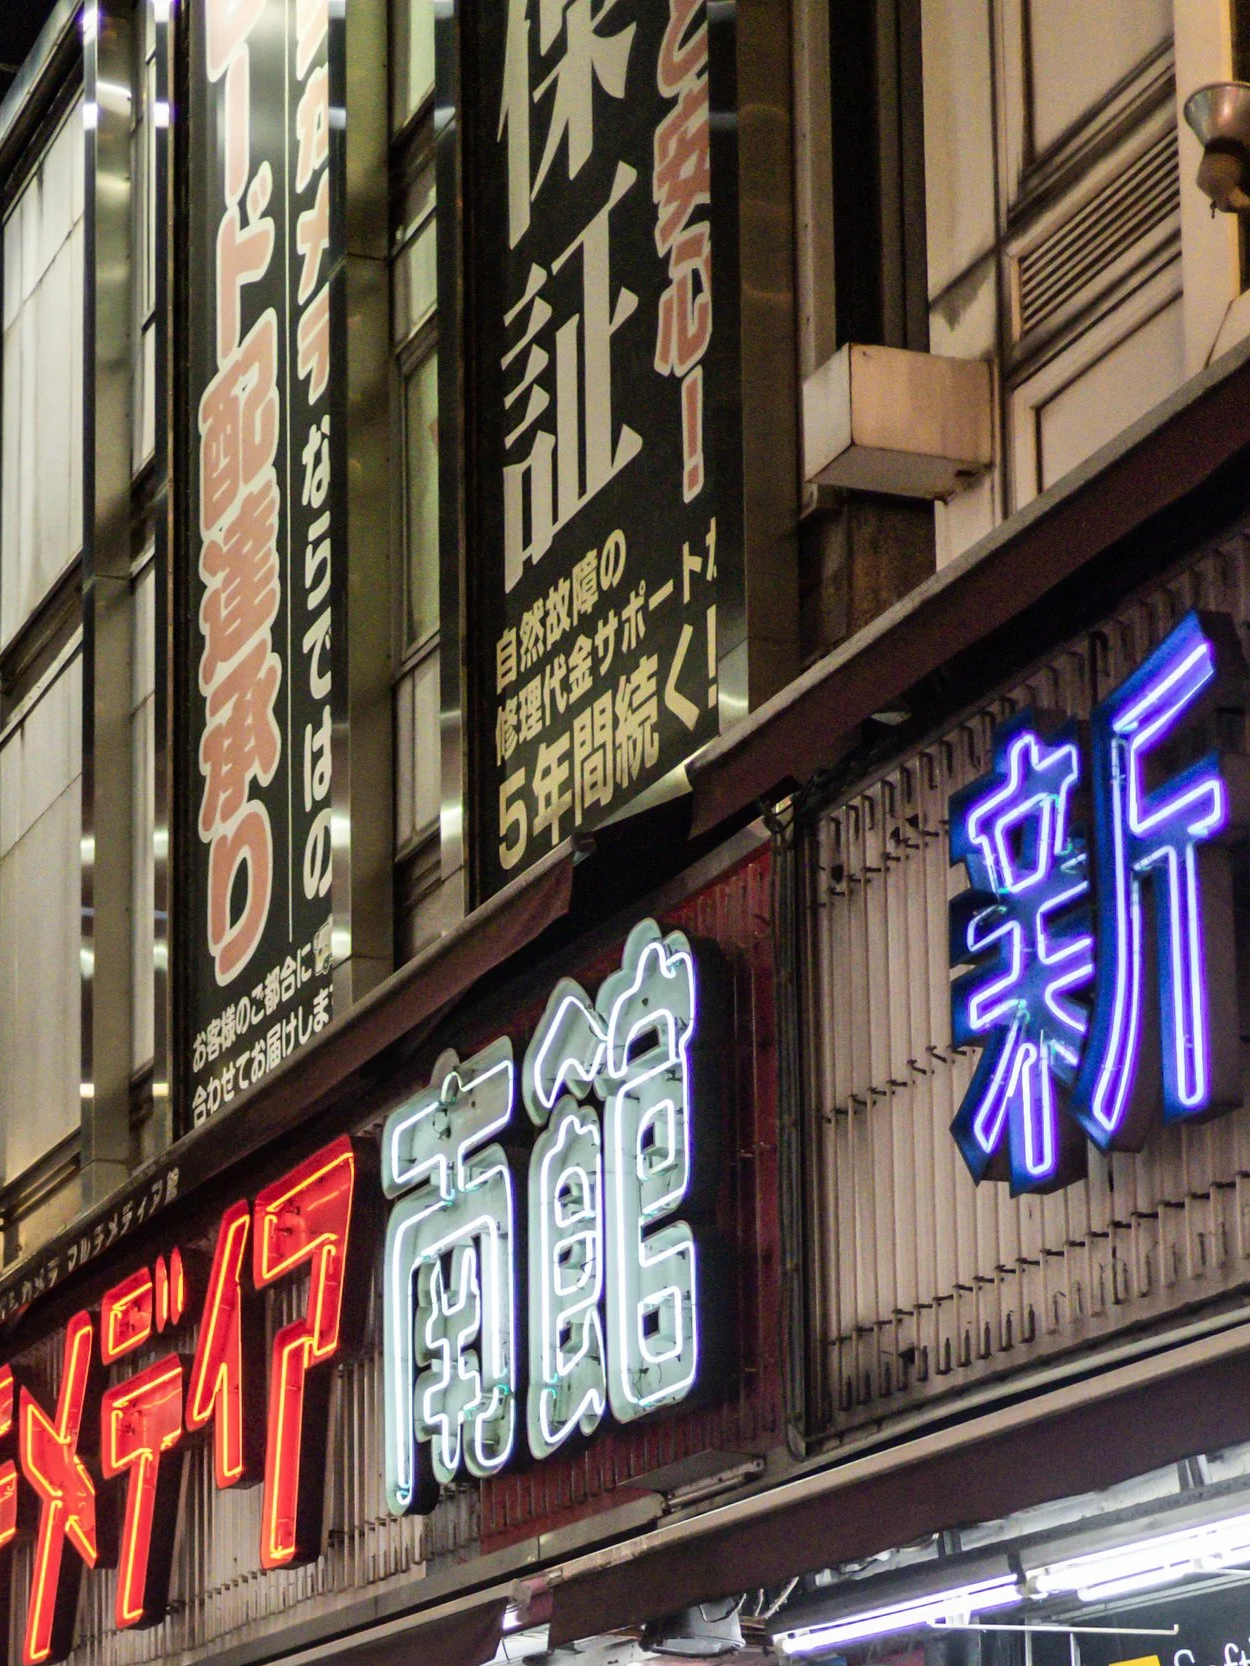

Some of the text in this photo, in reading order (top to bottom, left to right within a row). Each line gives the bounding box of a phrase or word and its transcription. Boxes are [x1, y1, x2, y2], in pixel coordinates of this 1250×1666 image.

[197, 0, 284, 987] ード配達承り
[496, 529, 626, 694] 自然故障の
[497, 605, 718, 870] 5年間続く!
[192, 942, 313, 1074] お客様のご都合に
[950, 611, 1228, 1198] 新
[192, 985, 333, 1130] 合わせてお届けしま
[382, 916, 704, 1520] 南館
